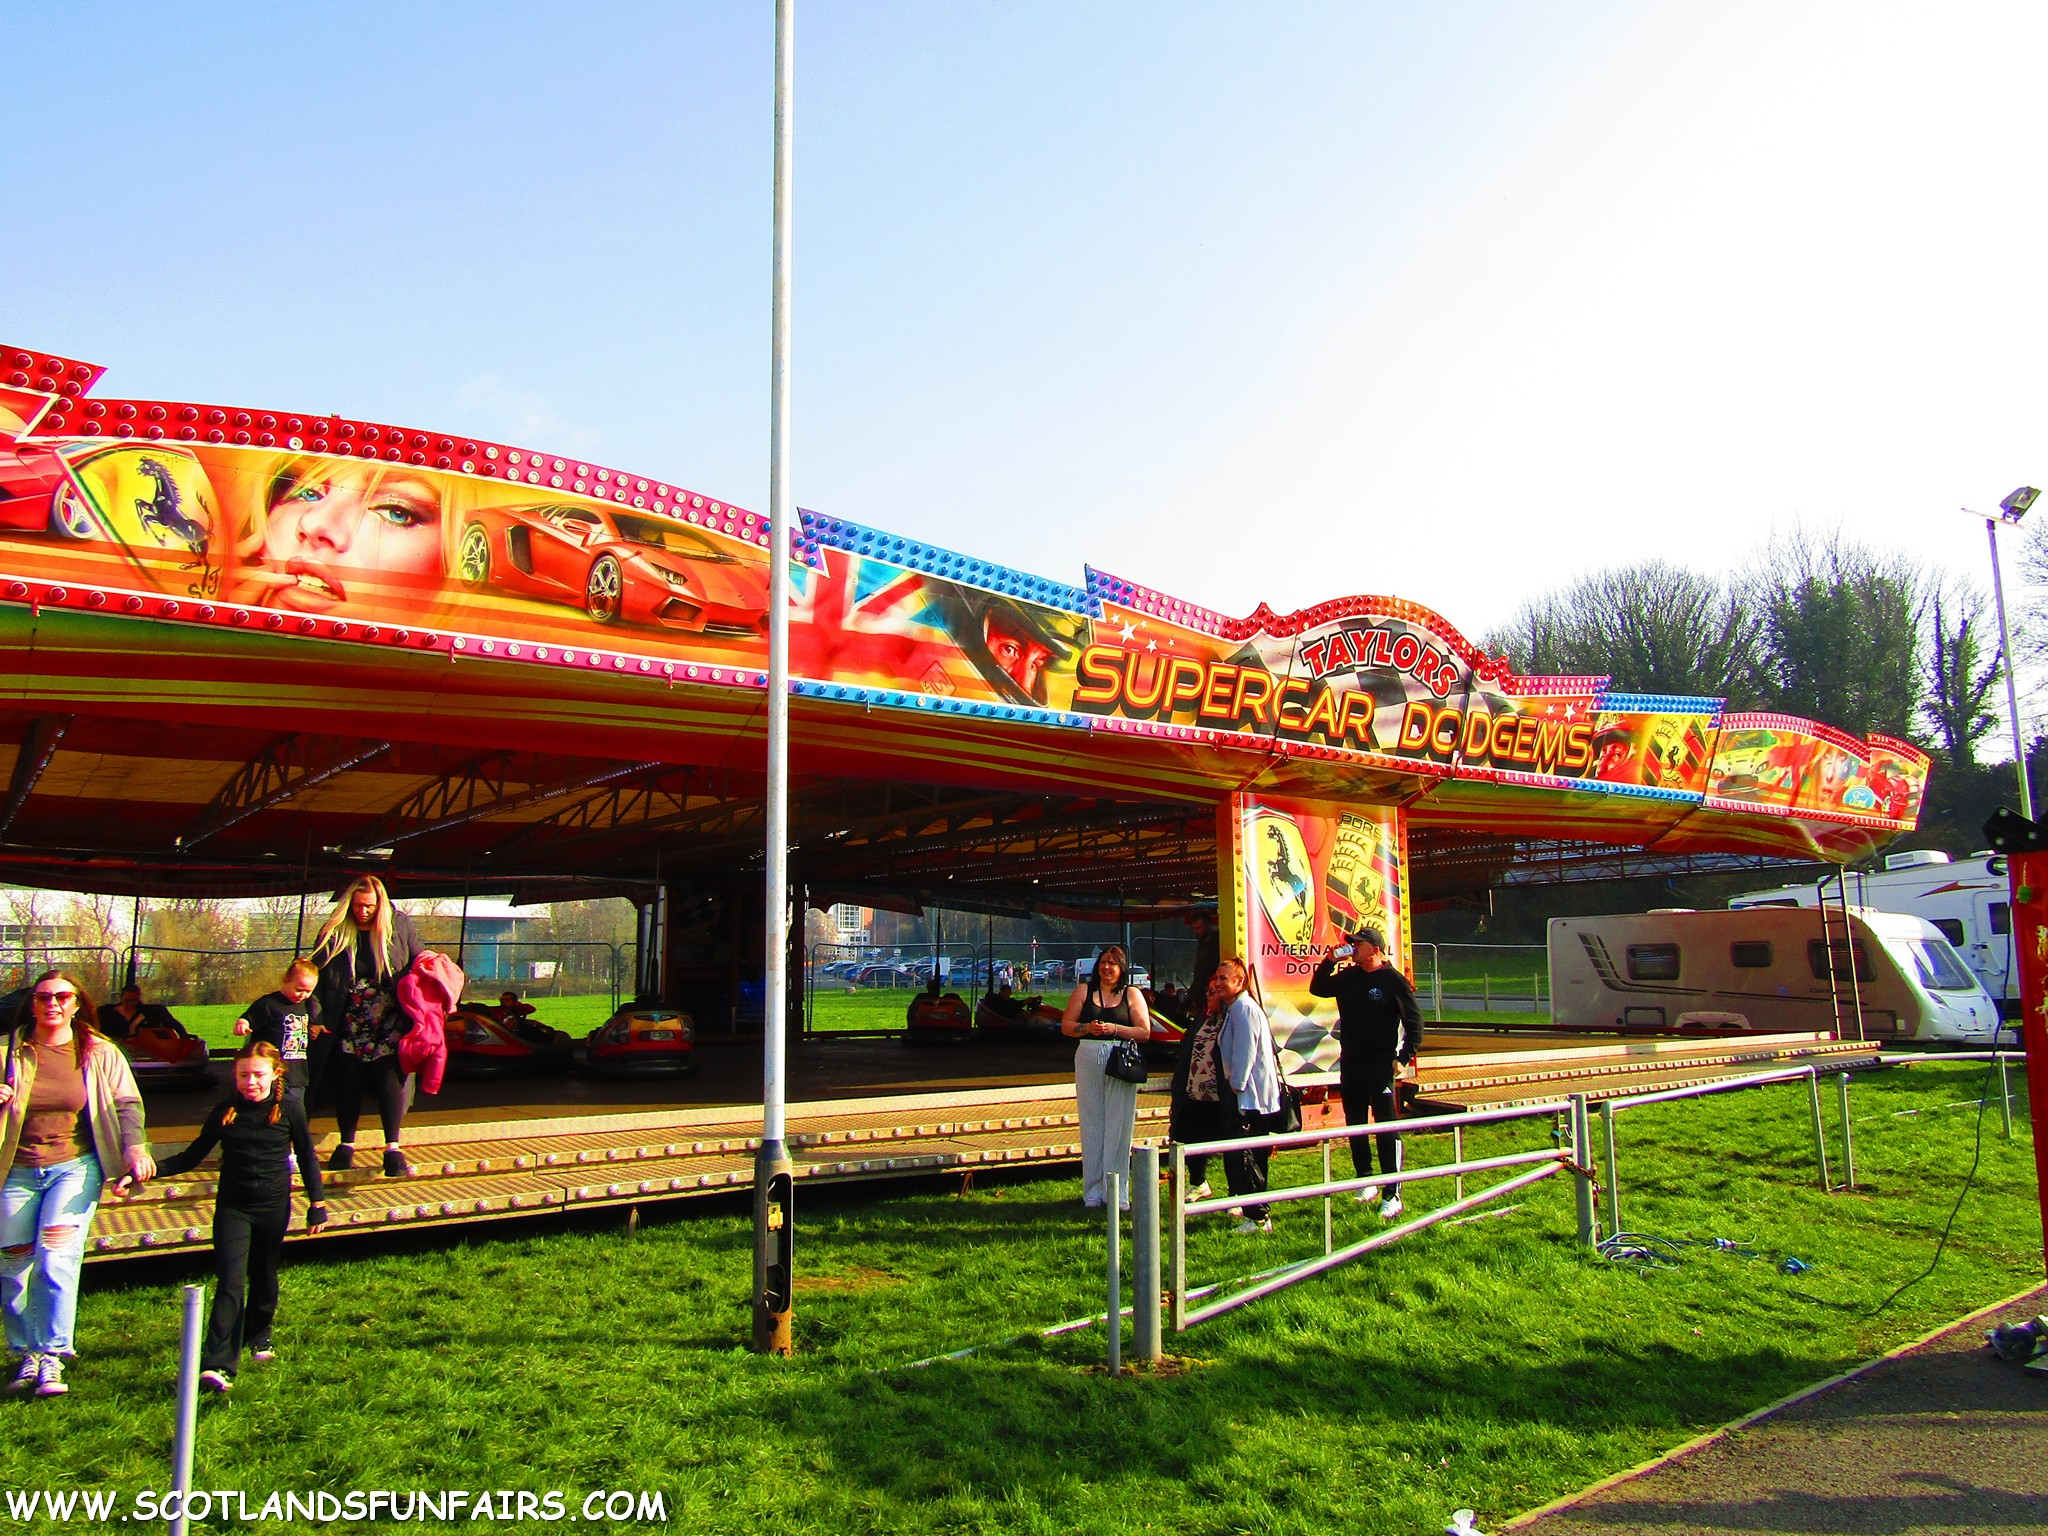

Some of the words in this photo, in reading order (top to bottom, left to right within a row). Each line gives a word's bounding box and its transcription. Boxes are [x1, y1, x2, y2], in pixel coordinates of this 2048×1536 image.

[1076, 643, 1376, 742] SUPERCAR
[1399, 699, 1596, 767] DODGEMS
[1301, 628, 1460, 698] TAYLORS
